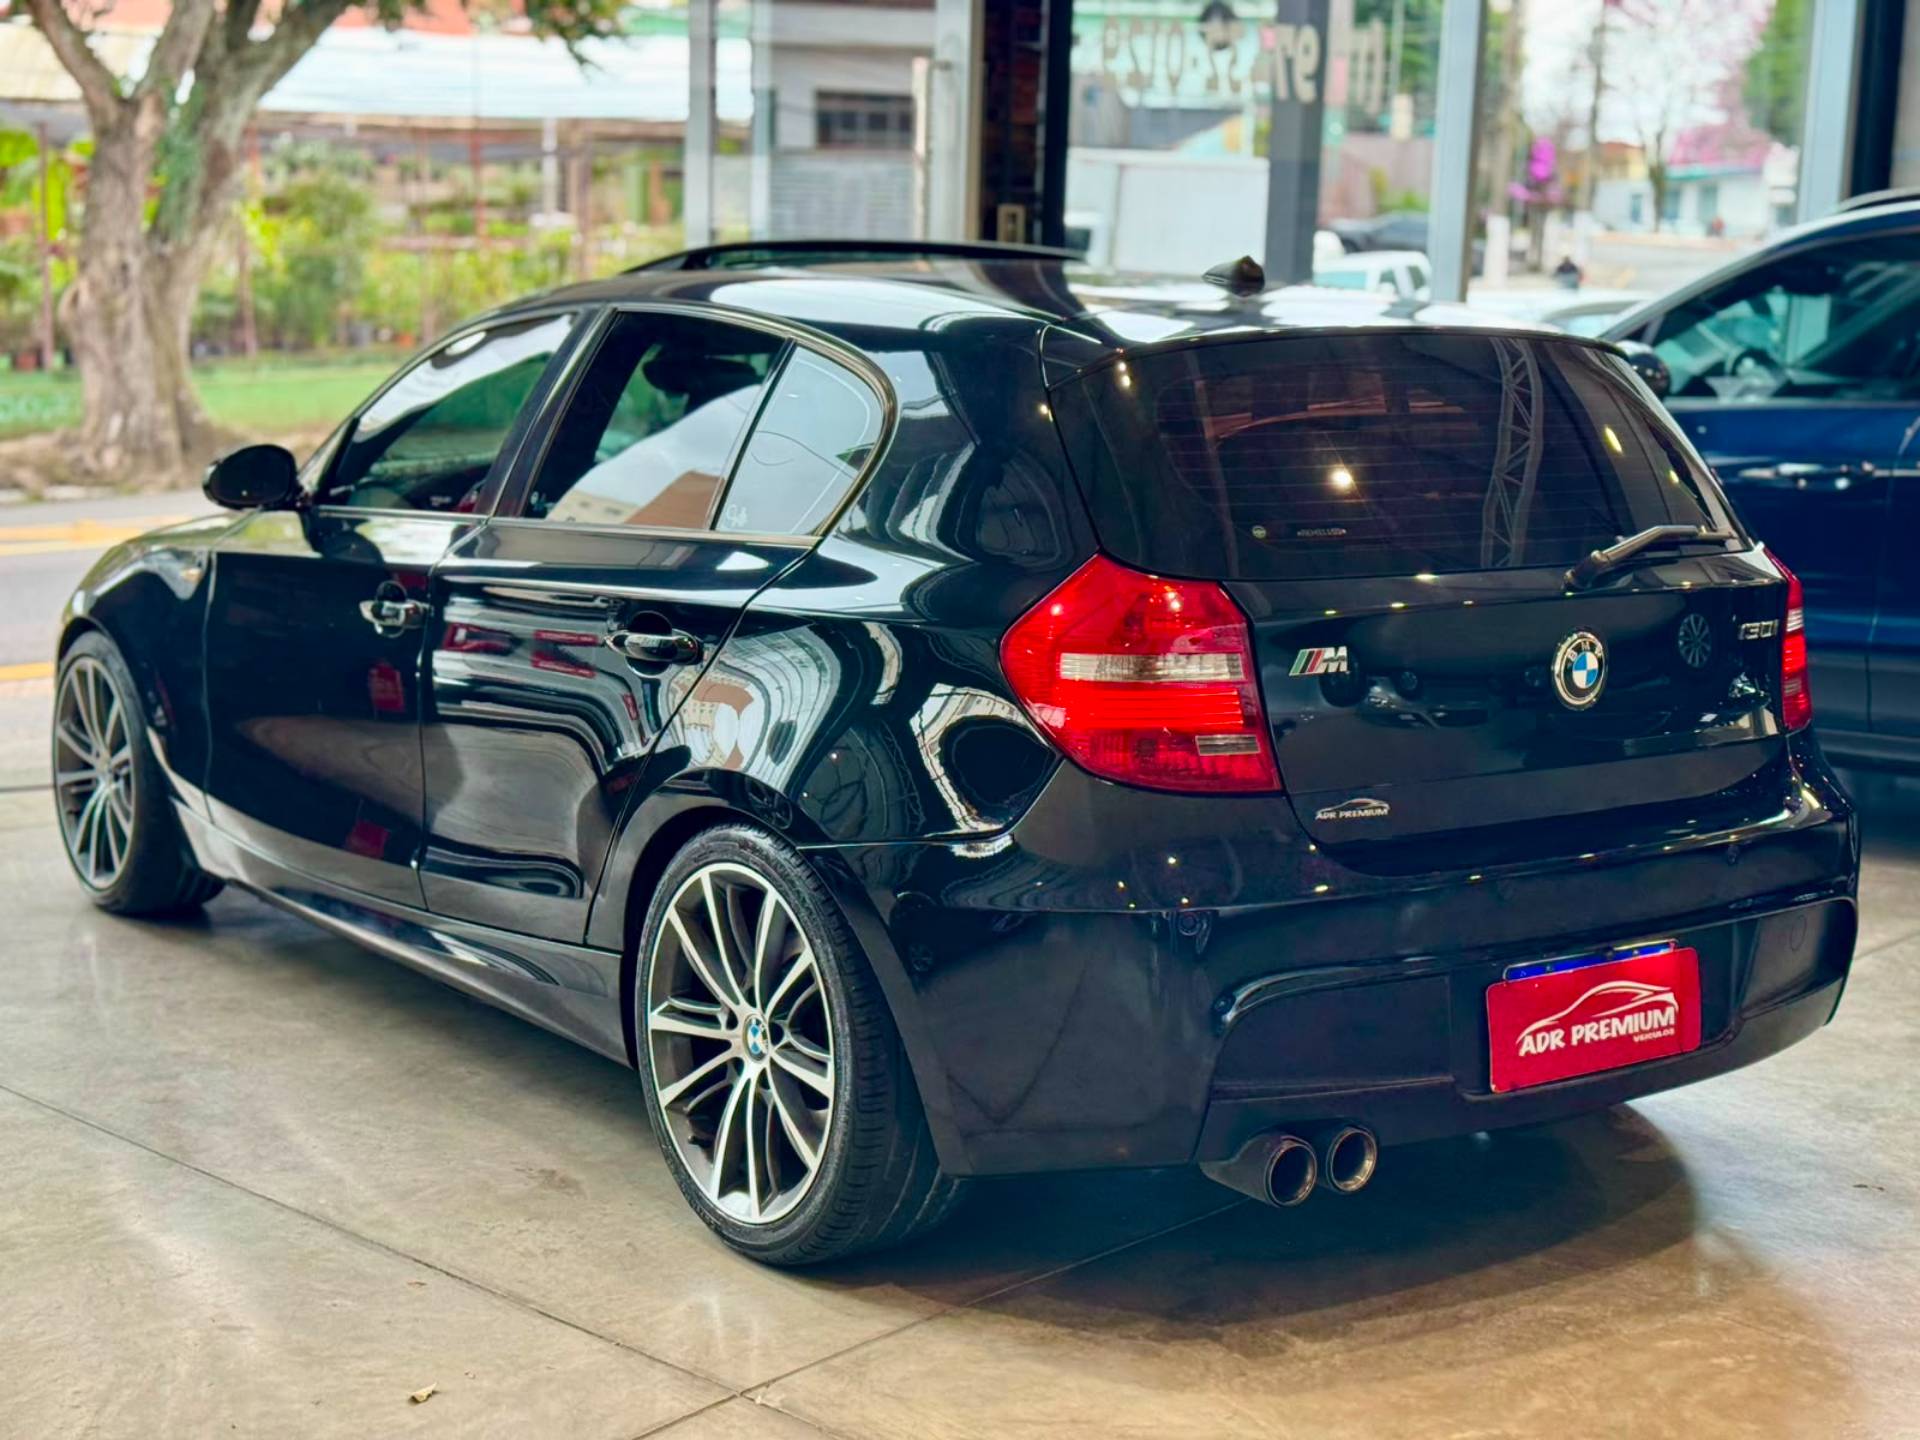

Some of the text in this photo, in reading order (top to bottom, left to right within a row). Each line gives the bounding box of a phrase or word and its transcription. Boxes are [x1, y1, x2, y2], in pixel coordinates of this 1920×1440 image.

[1316, 808, 1388, 820] ADR PREMIUM
[1519, 1007, 1675, 1056] ADR PREMIUM
